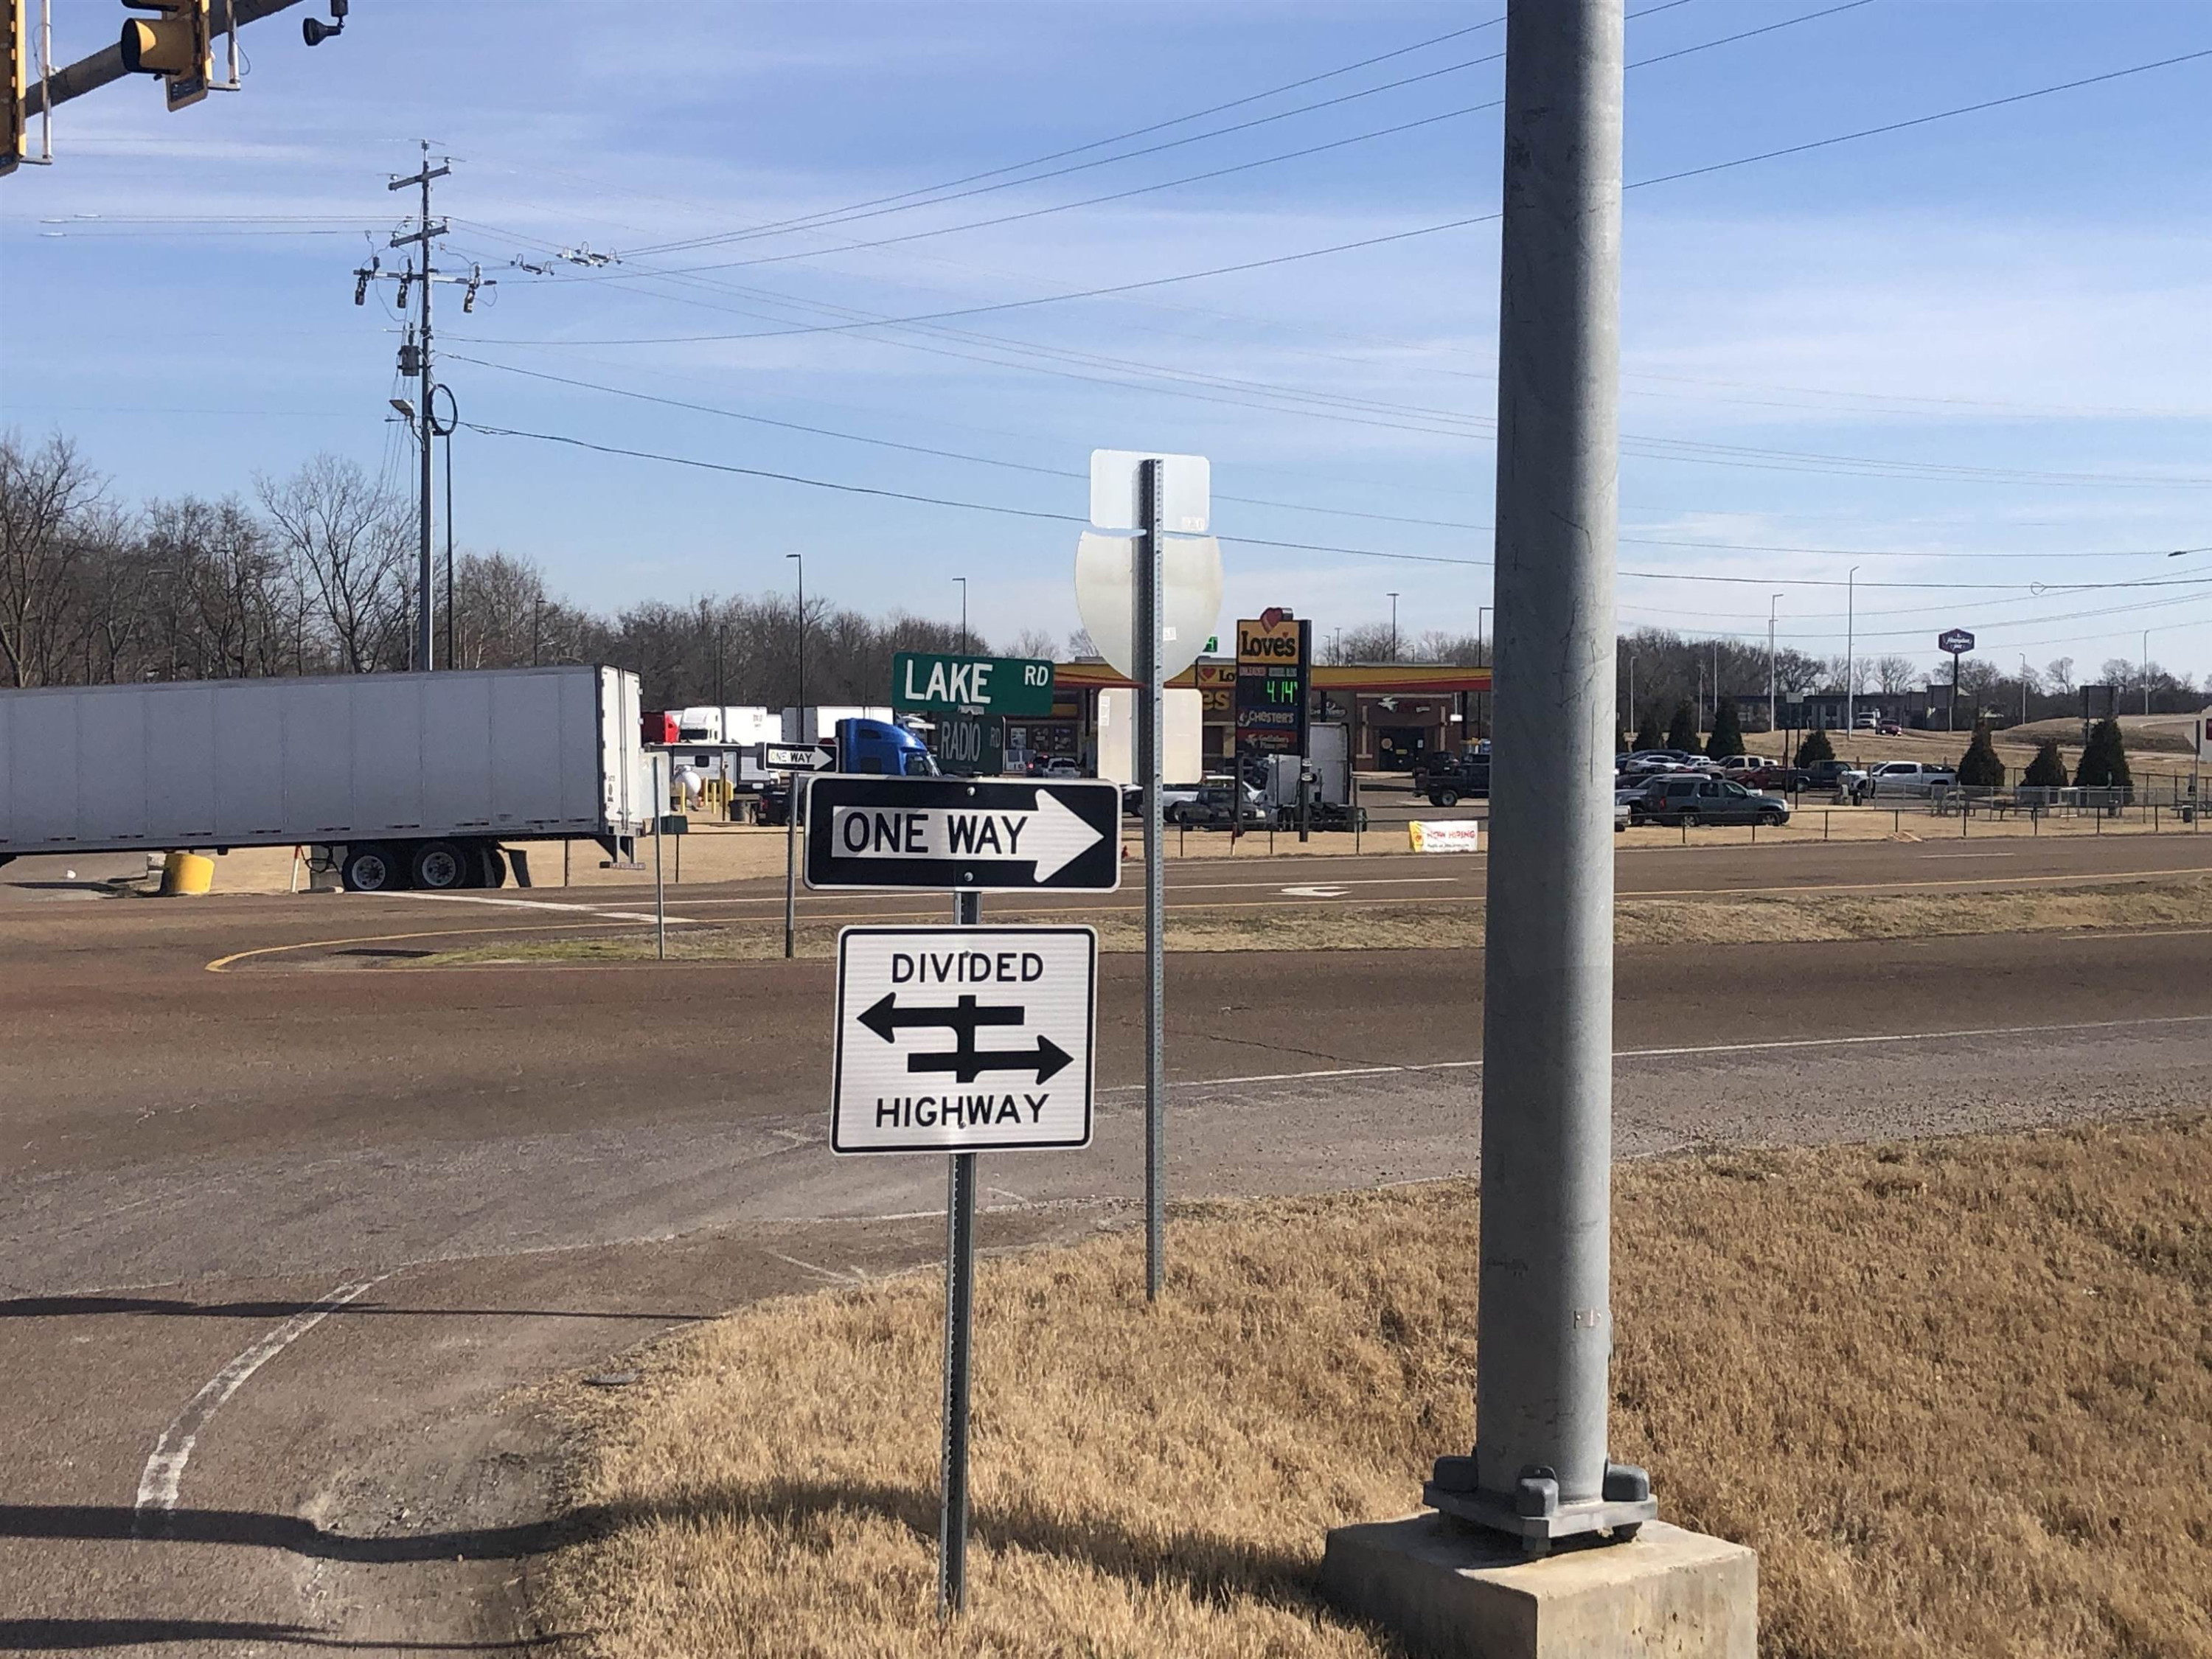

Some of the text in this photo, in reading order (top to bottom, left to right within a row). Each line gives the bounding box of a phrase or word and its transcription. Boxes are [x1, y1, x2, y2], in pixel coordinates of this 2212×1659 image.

[905, 659, 1048, 704] LAKE RD
[771, 751, 812, 763] ONE WAY
[941, 721, 981, 762] RADIO
[990, 726, 1001, 748] RD
[844, 812, 1028, 855] ONE WAY
[892, 953, 1043, 984] DIVIDED
[876, 1093, 1050, 1127] HIGHWAY
